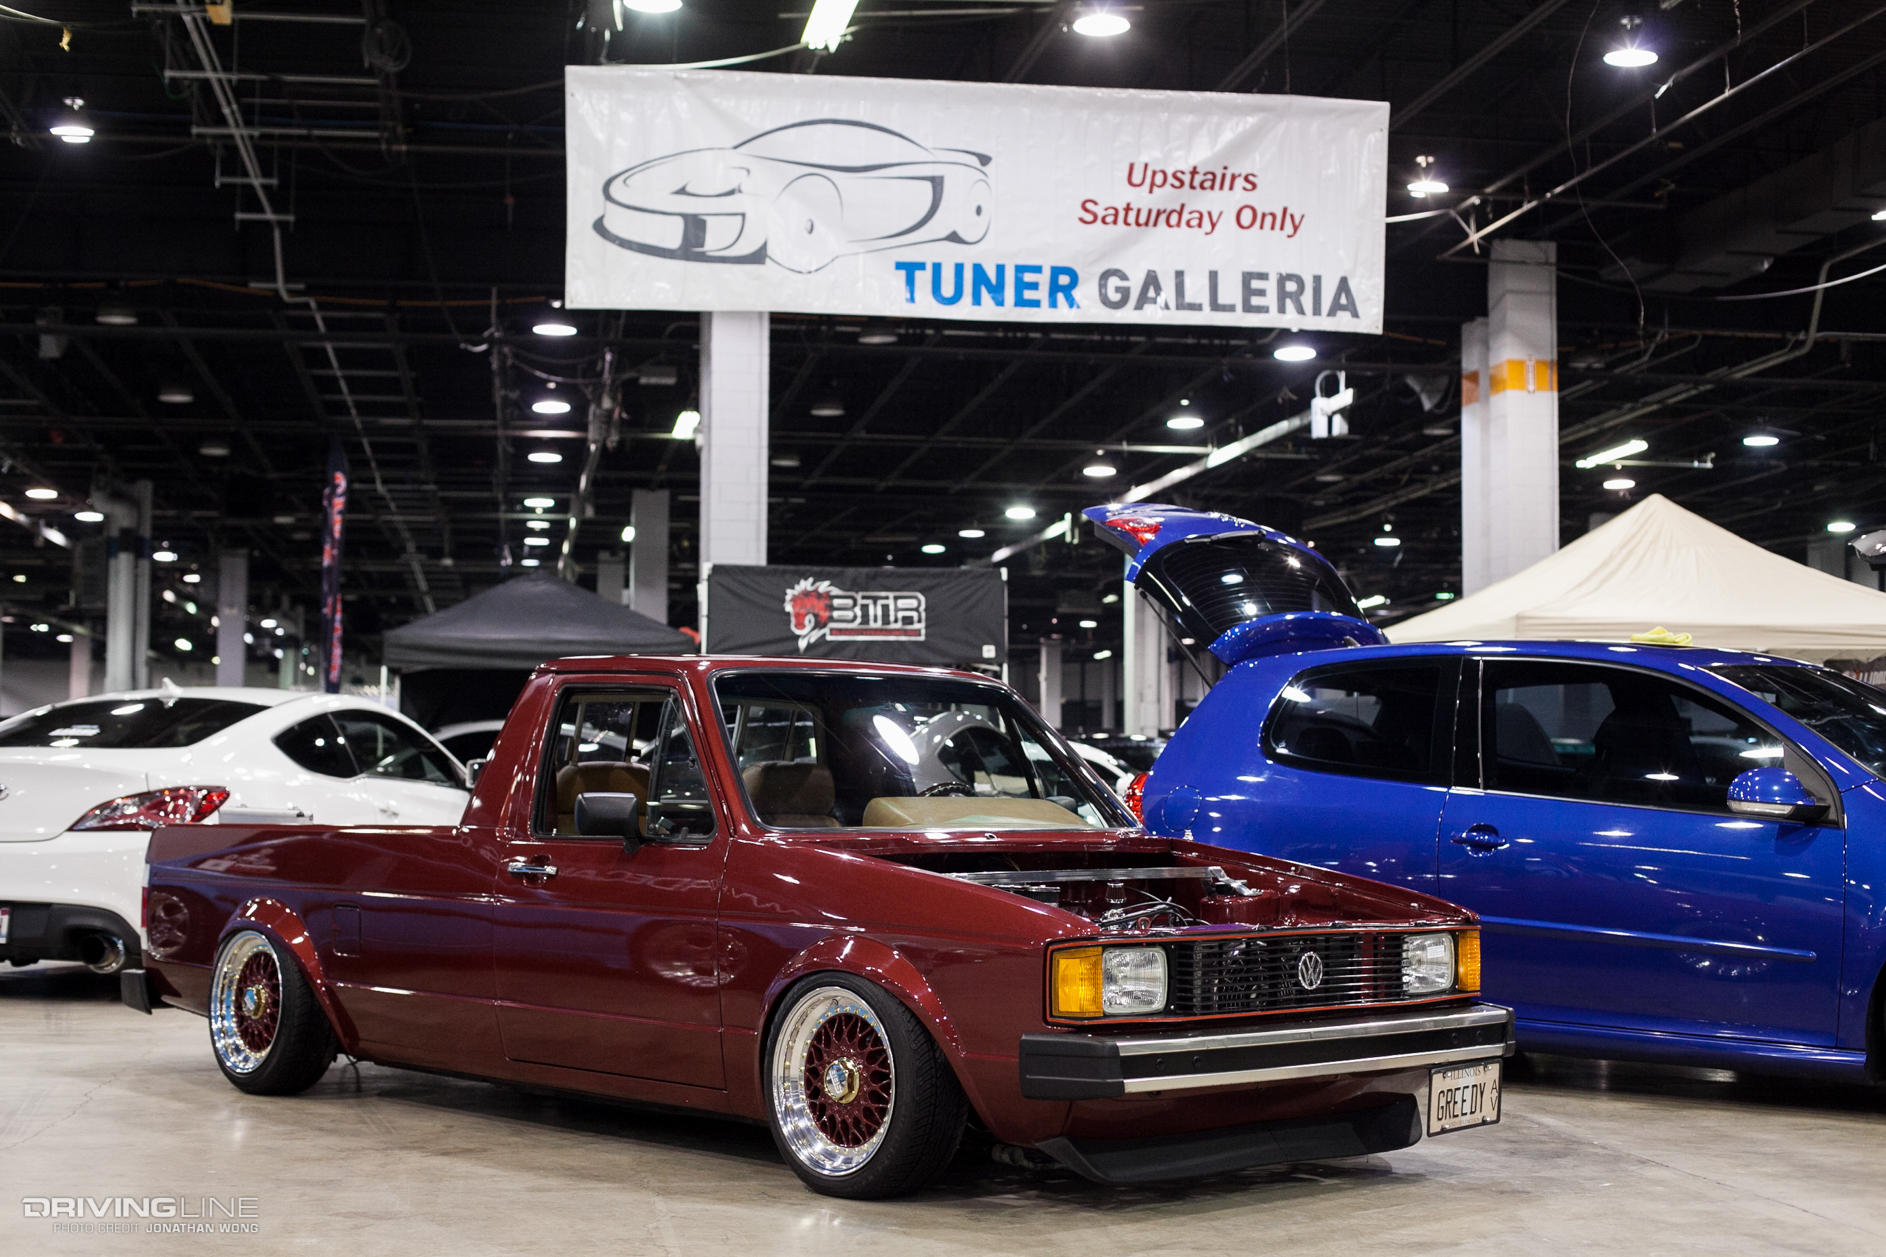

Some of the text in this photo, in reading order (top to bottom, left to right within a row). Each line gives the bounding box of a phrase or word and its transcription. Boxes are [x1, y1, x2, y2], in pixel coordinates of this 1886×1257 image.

[1126, 163, 1258, 194] Upstairs
[1079, 200, 1302, 239] Saturday Only
[894, 260, 1361, 319] TUNER GALLERIA
[1450, 1066, 1482, 1081] ILLINOIS
[1436, 1082, 1486, 1121] GREEDY
